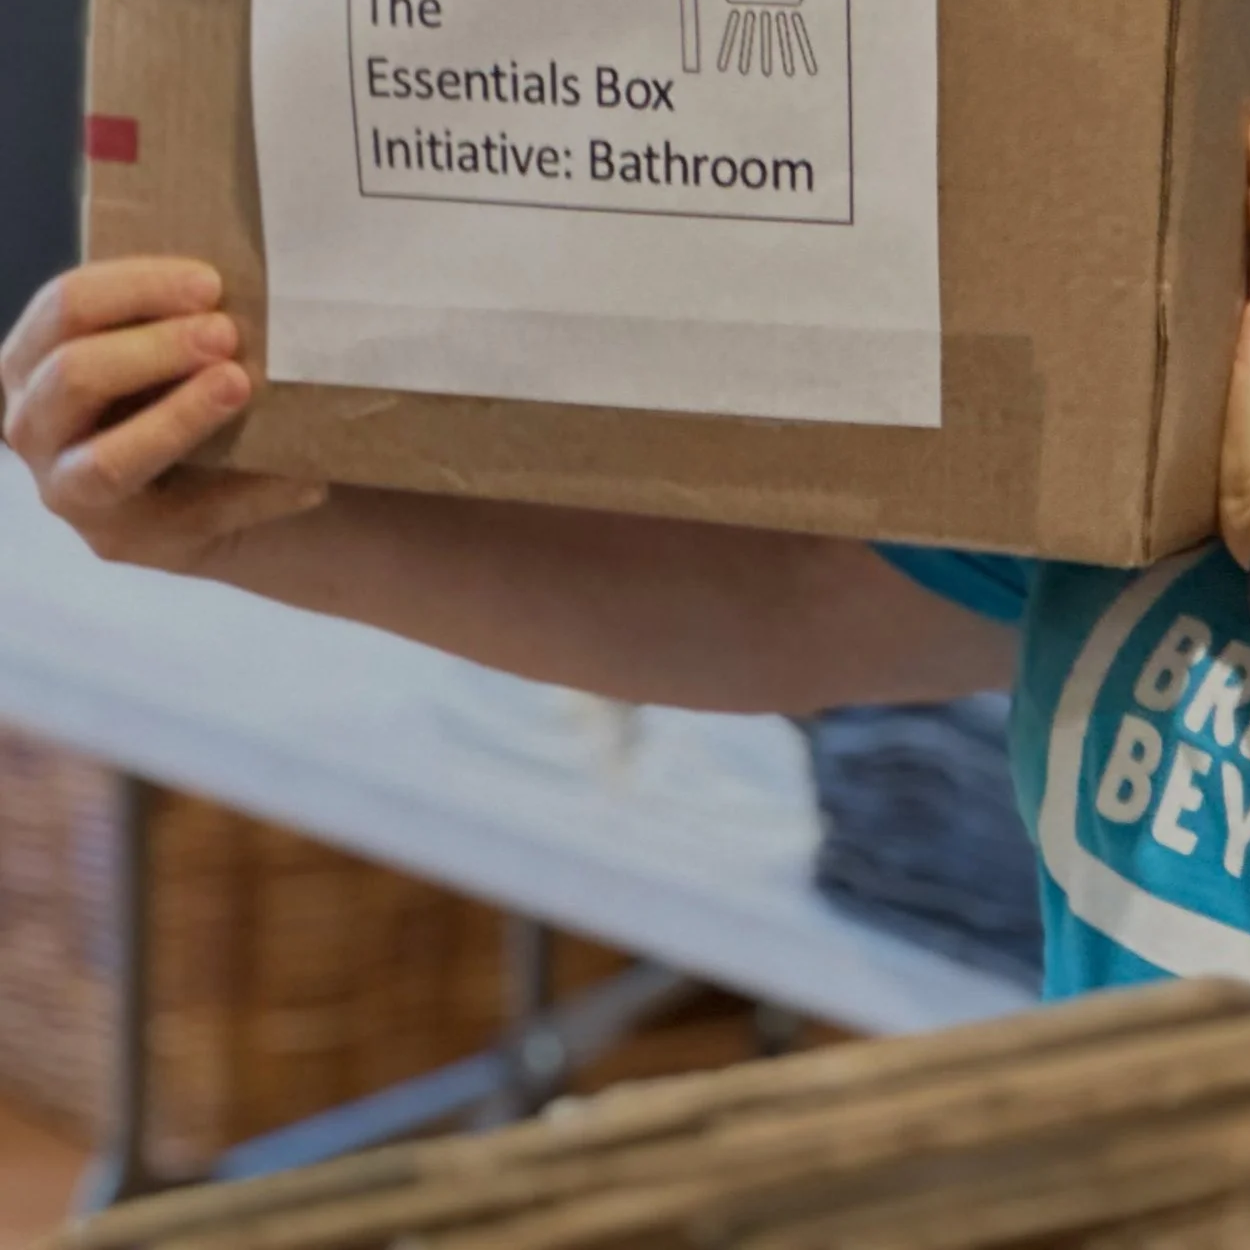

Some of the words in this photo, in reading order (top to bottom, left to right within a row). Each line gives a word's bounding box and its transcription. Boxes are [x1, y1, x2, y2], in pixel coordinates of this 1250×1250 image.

[366, 57, 581, 107] Essentials
[595, 67, 676, 112] Box
[371, 128, 573, 179] Initiative:
[589, 140, 814, 192] Bathroom
